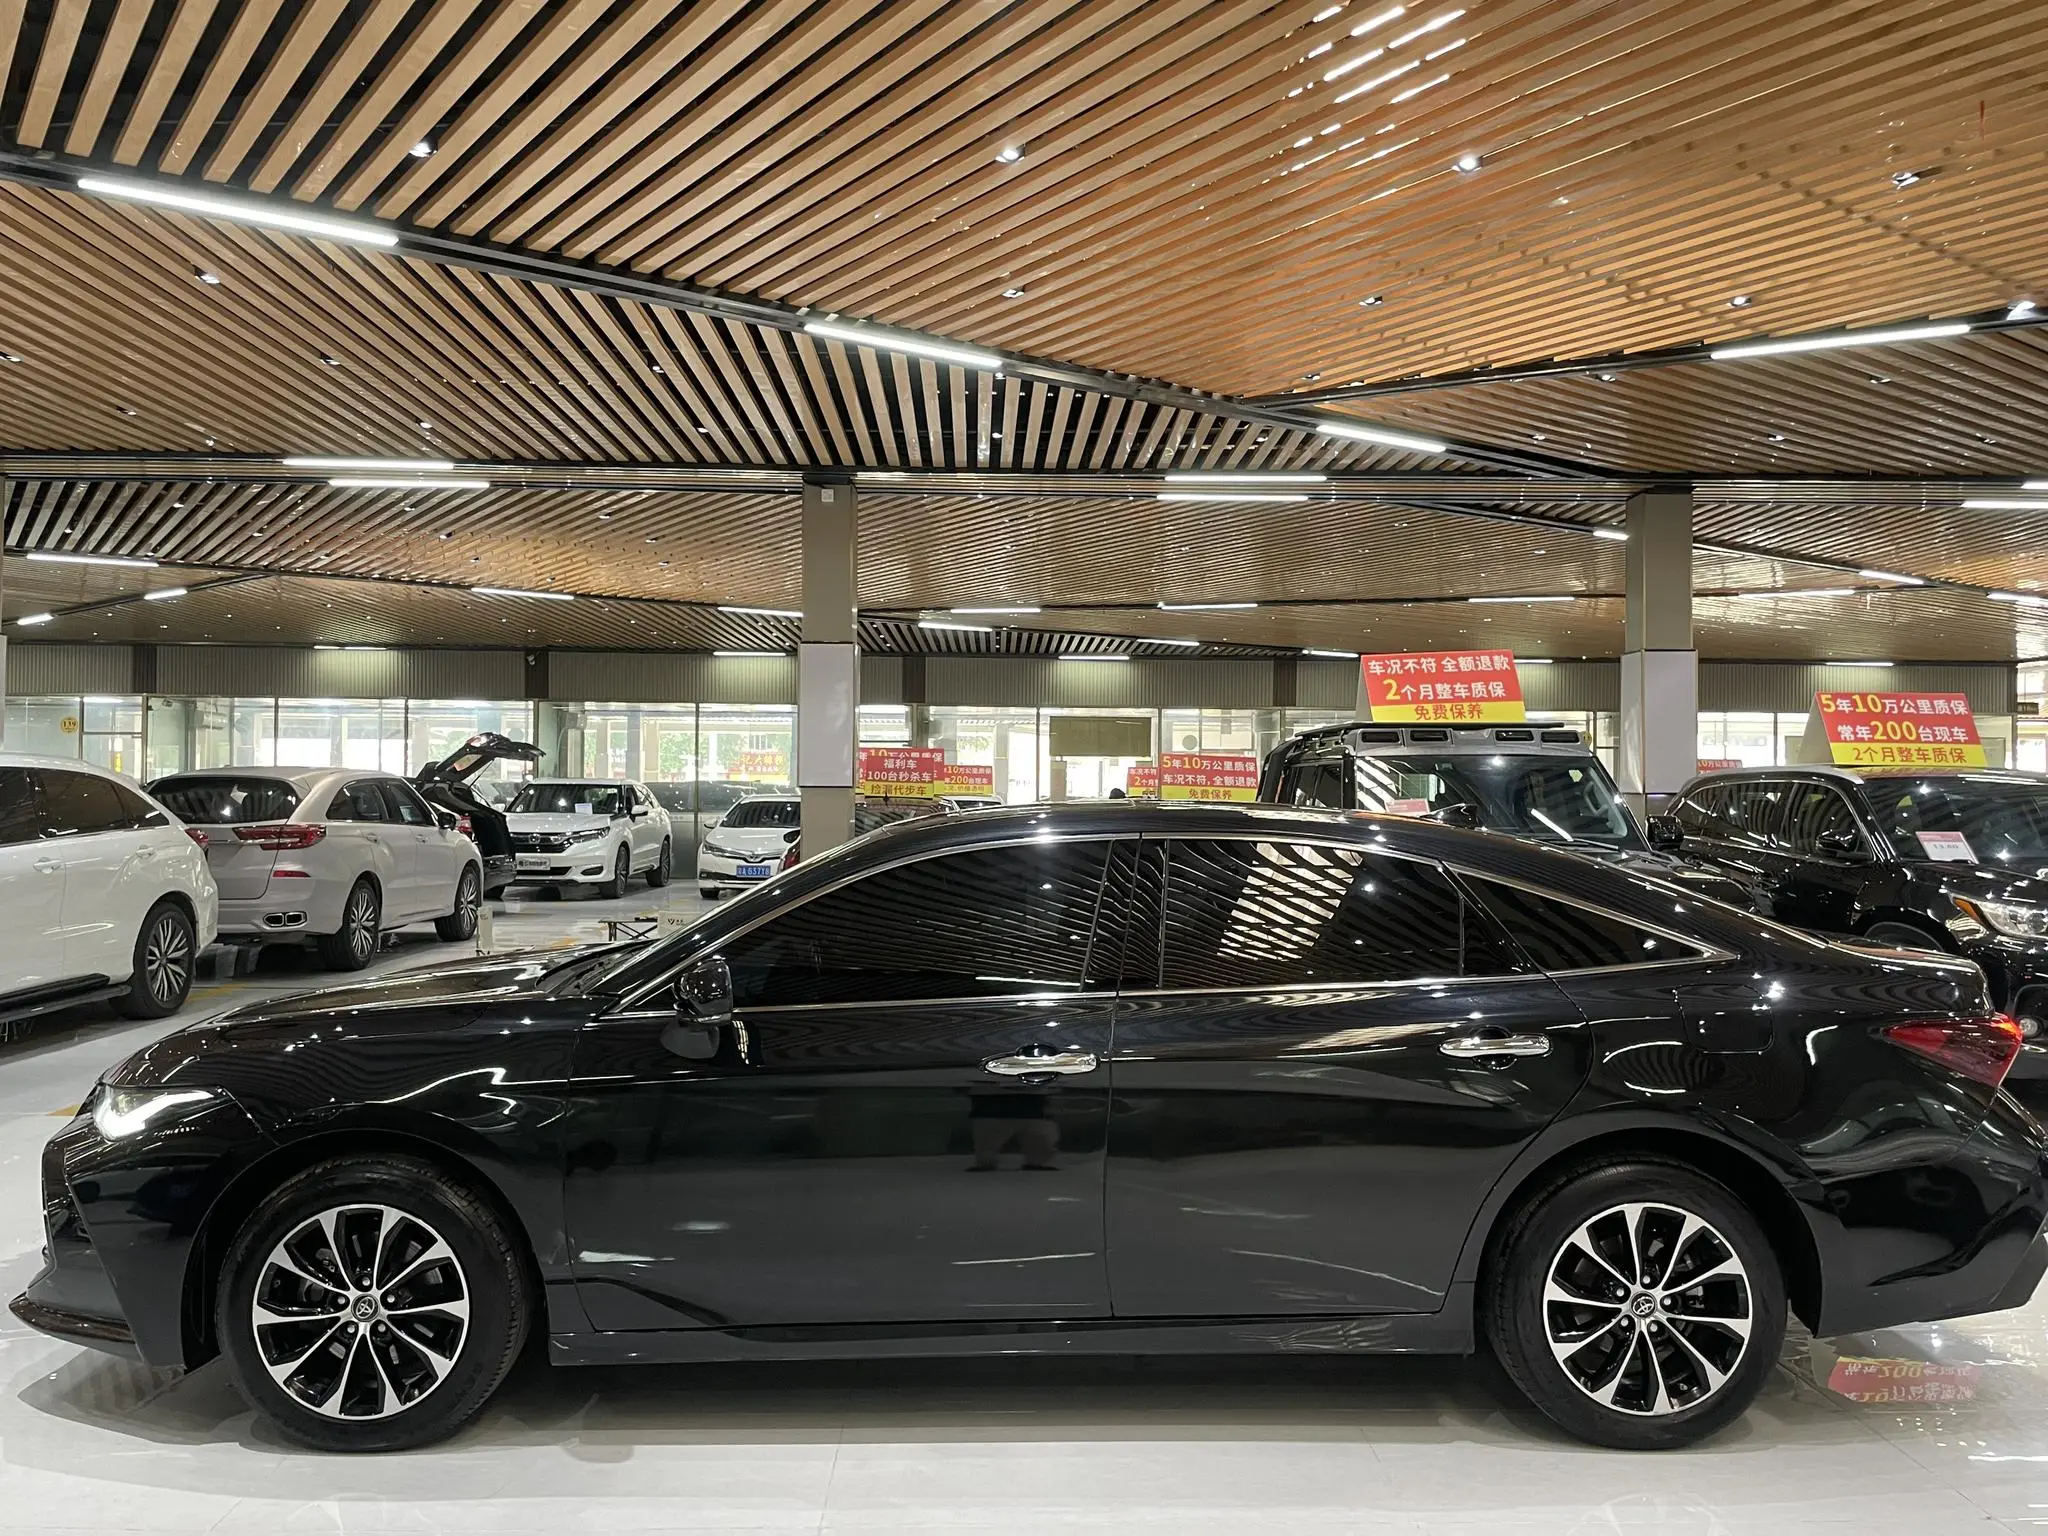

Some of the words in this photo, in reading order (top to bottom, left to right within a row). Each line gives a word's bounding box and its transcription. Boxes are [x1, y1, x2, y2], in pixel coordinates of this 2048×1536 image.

[1368, 656, 1437, 675] 车况不符
[1441, 654, 1511, 673] 全额退款
[1383, 679, 1506, 700] 2个月整车质保
[1415, 703, 1484, 721] 免费保养
[1820, 694, 1969, 715] 5年10万公里质保
[1837, 721, 1969, 742] 常年200台现车
[884, 758, 917, 769] 福利车
[1162, 755, 1256, 772] 5年10万公里质保
[1853, 747, 1967, 763] 2个月整车质保
[867, 770, 932, 783] 100台秒杀车
[1134, 776, 1158, 786] 2个月
[1189, 788, 1232, 800] 免费保养
